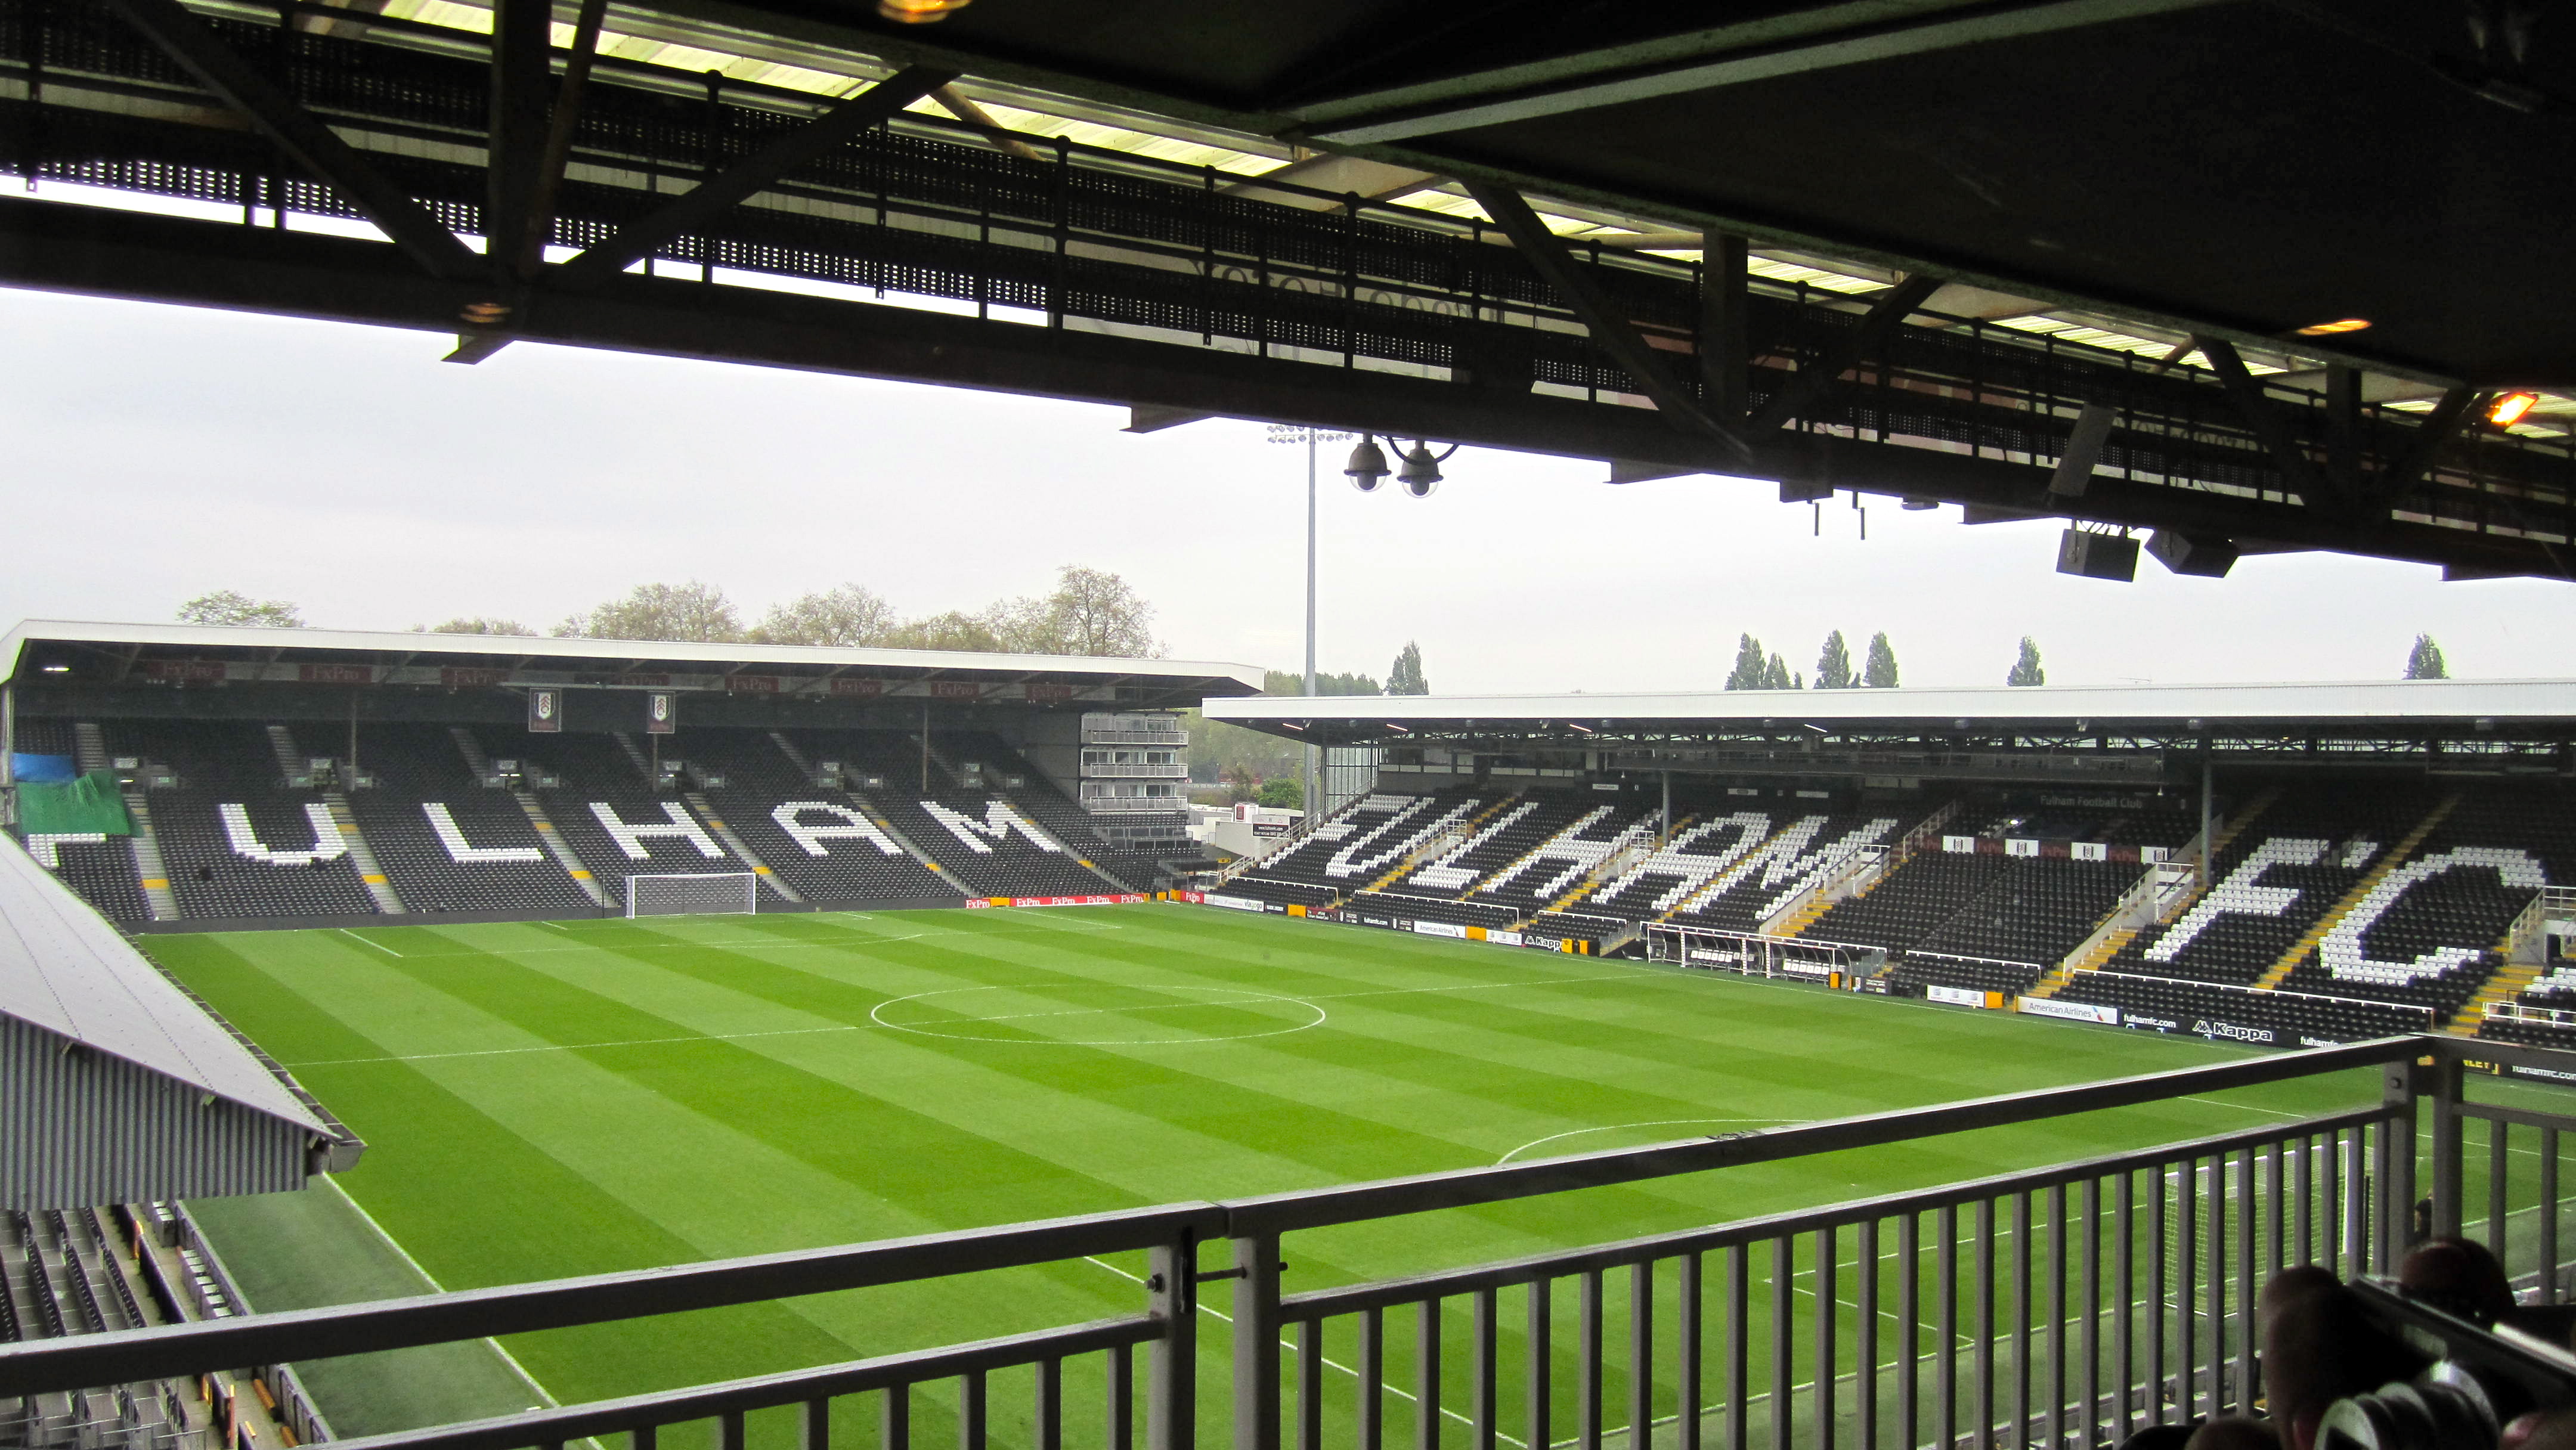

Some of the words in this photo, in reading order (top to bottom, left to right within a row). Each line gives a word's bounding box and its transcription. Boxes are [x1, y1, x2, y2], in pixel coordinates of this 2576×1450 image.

[733, 677, 772, 692] FxPro
[838, 680, 875, 693] FxPro
[937, 684, 973, 695] FxPro
[1033, 687, 1065, 698] FxPro
[2041, 795, 2075, 806] Fulham
[2077, 796, 2117, 807] Football
[2120, 797, 2142, 808] Club
[1259, 794, 1897, 920] FULHAM
[2144, 838, 2546, 986] FC
[1016, 898, 1040, 906] FxPro
[1051, 897, 1075, 905] FxPro
[1087, 896, 1109, 904] FxPro
[1121, 895, 1144, 903] FxPro
[1185, 892, 1200, 902] FxPro
[966, 900, 990, 909] FxPro
[1244, 900, 1262, 911] viagogo
[1420, 925, 1438, 933] American
[1438, 927, 1453, 935] Airlines
[1535, 935, 1562, 949] Kapp
[2029, 1002, 2063, 1014] American
[2064, 1005, 2092, 1018] Airlines
[2123, 1014, 2176, 1028] fulhamfc.com
[2213, 1021, 2274, 1042] Kappa
